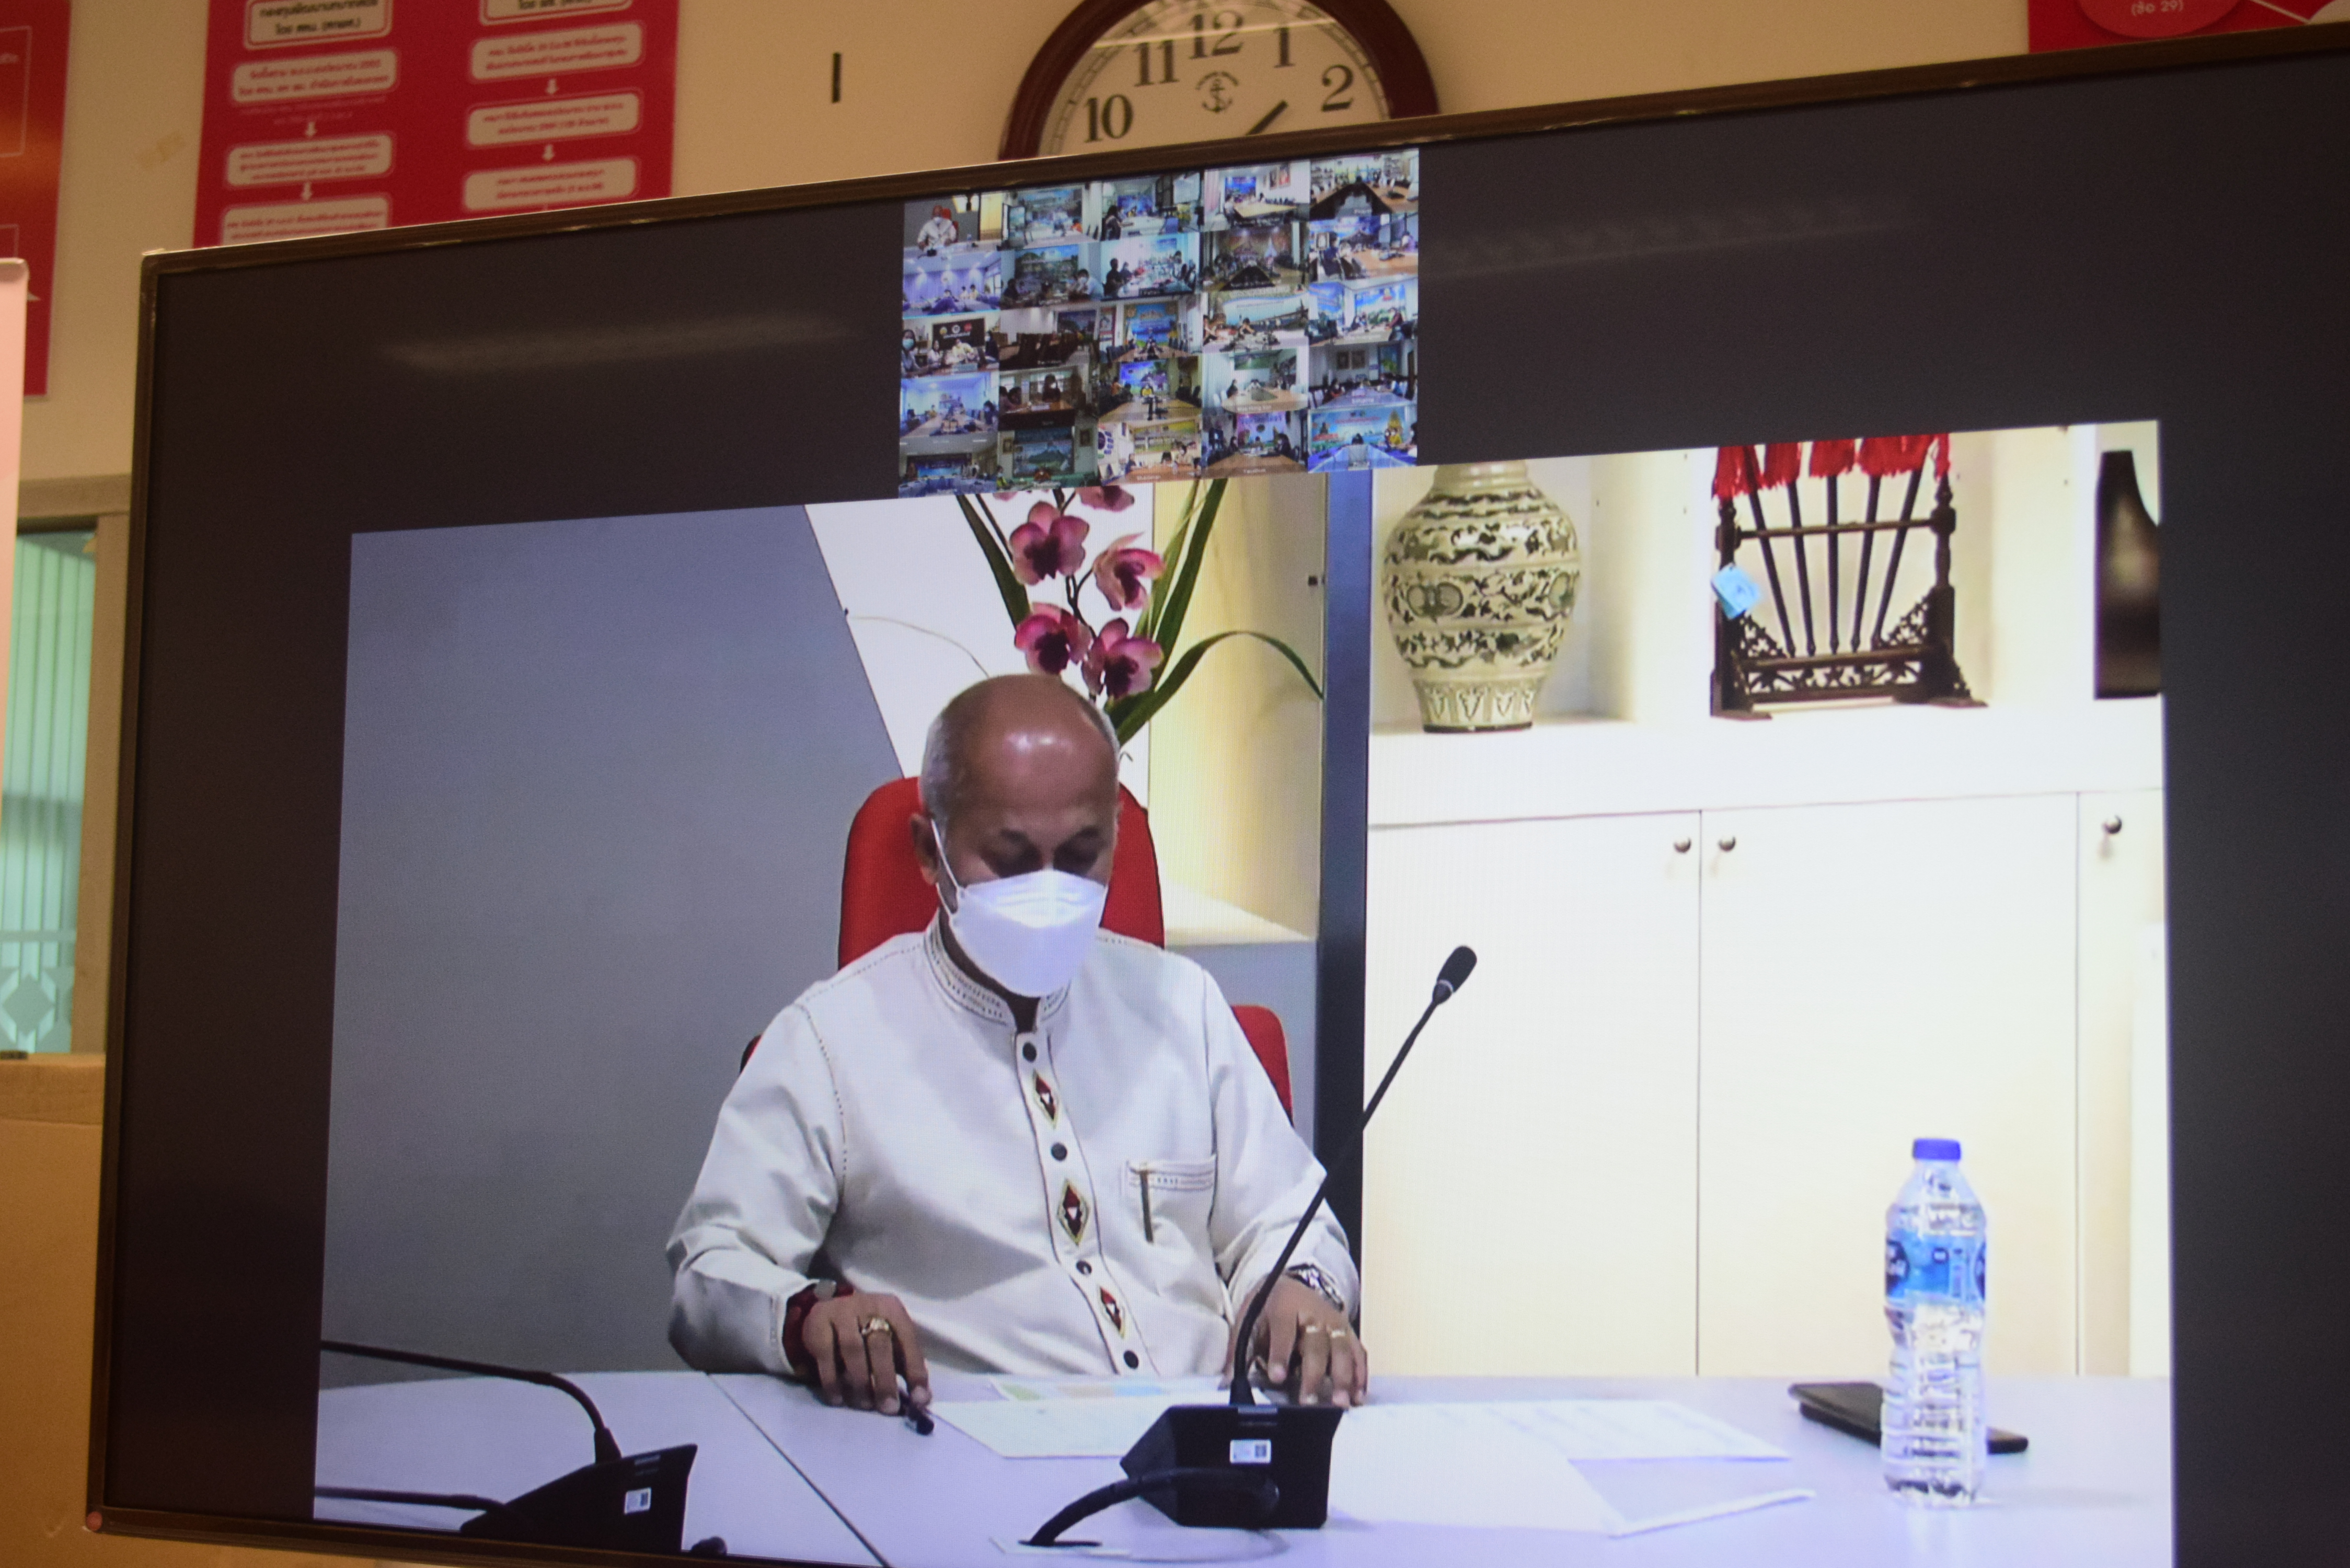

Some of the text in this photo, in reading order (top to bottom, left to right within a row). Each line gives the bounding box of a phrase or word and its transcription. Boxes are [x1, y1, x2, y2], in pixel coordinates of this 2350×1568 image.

[2160, 0, 2184, 12] 29)
[1189, 10, 1244, 60] 12
[1274, 27, 1295, 68] 1
[1134, 39, 1180, 87] 11
[1321, 64, 1355, 112] 2
[1084, 94, 1134, 143] 10
